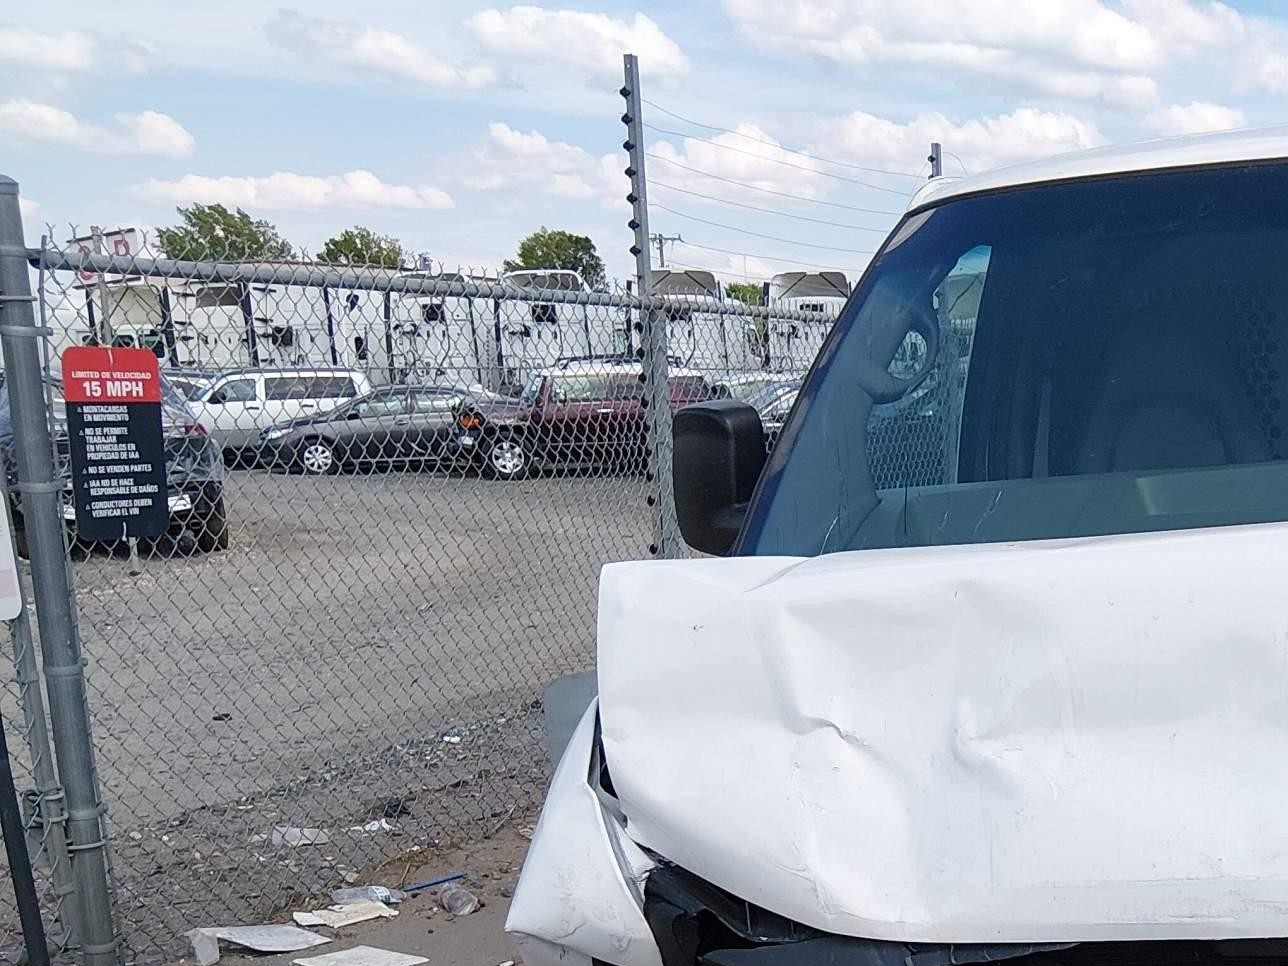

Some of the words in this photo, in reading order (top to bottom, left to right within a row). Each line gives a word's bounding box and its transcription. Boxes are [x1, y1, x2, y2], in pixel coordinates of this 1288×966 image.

[82, 381, 102, 397] 15
[106, 381, 144, 397] MPH
[95, 427, 102, 435] SE
[103, 427, 128, 435] PERMITE
[86, 444, 95, 452] EN
[87, 452, 119, 460] PROPIEDAD
[88, 466, 97, 474] NO
[98, 466, 106, 474] SE
[106, 465, 130, 473] VENDEN
[130, 464, 152, 472] PARTES
[101, 479, 110, 487] NO
[90, 486, 130, 496] RESPONSABLE
[139, 483, 159, 493] DAÑOS
[91, 500, 132, 509] CONDUCTORES
[92, 509, 121, 518] VERIFICAR
[121, 508, 128, 516] EL
